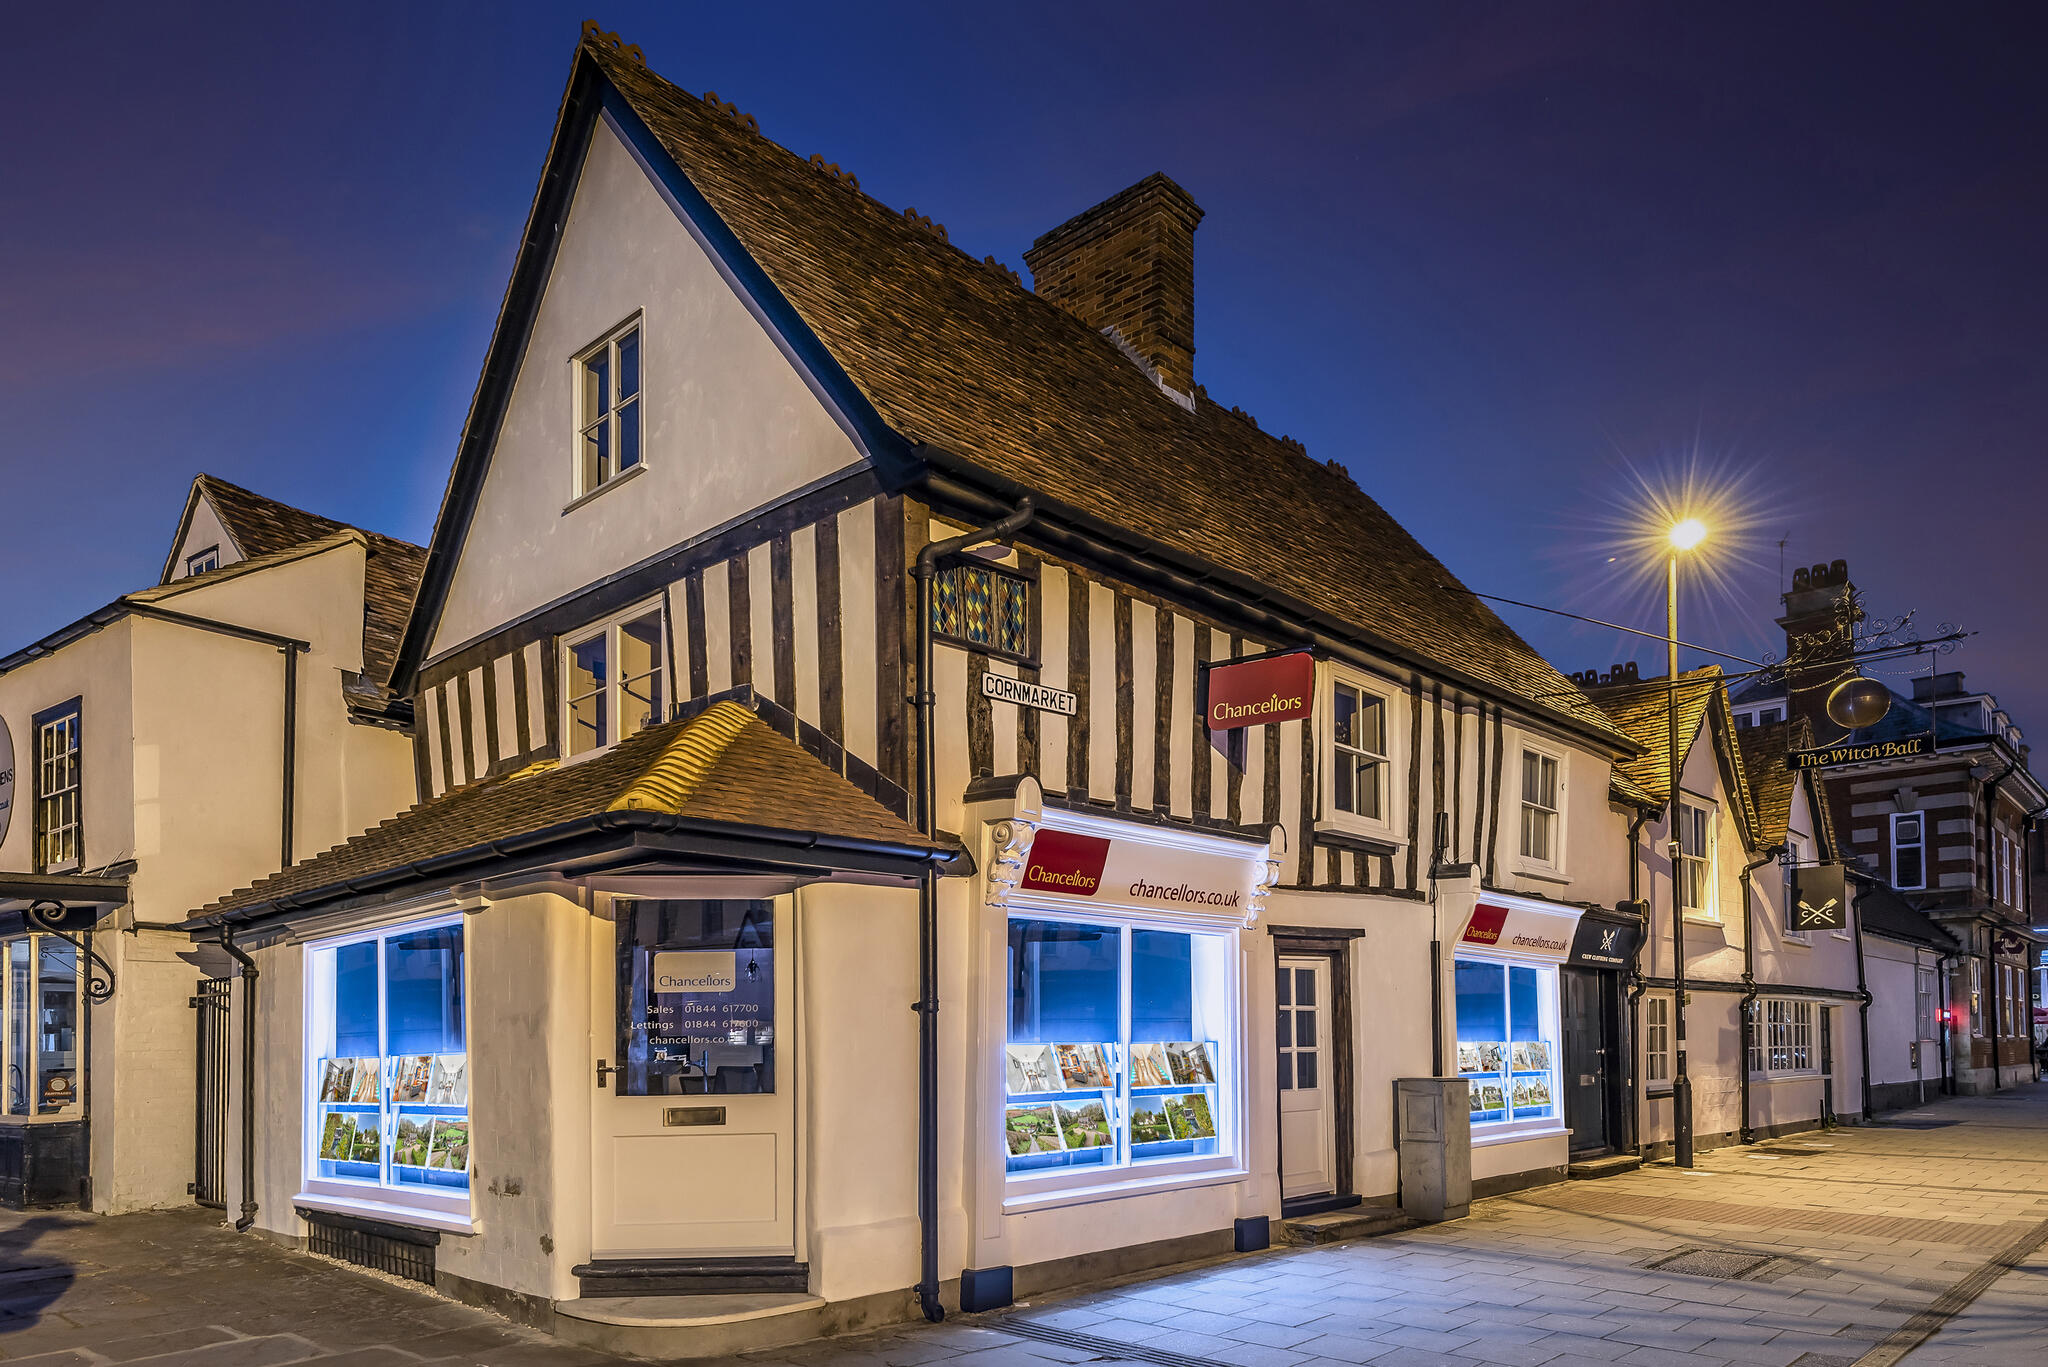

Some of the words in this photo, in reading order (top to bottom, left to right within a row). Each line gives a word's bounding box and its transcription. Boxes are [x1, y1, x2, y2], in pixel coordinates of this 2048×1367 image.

[986, 677, 1074, 712] CORNMARKET
[1213, 693, 1302, 720] Chancellors
[1797, 753, 1829, 767] The
[1830, 745, 1881, 762] Witch
[1882, 739, 1922, 757] Ball
[1028, 865, 1096, 888] Chancellors
[1129, 879, 1240, 907] chancellors.co.uk
[1466, 926, 1498, 940] Chancellors
[1512, 933, 1568, 951] chancellors.co.uk
[659, 975, 731, 987] Chancellors
[647, 1005, 674, 1014] Sales
[684, 1004, 717, 1013] 01844
[722, 1004, 759, 1013] 617700
[631, 1021, 674, 1031] Lettings
[684, 1020, 717, 1029] 01844
